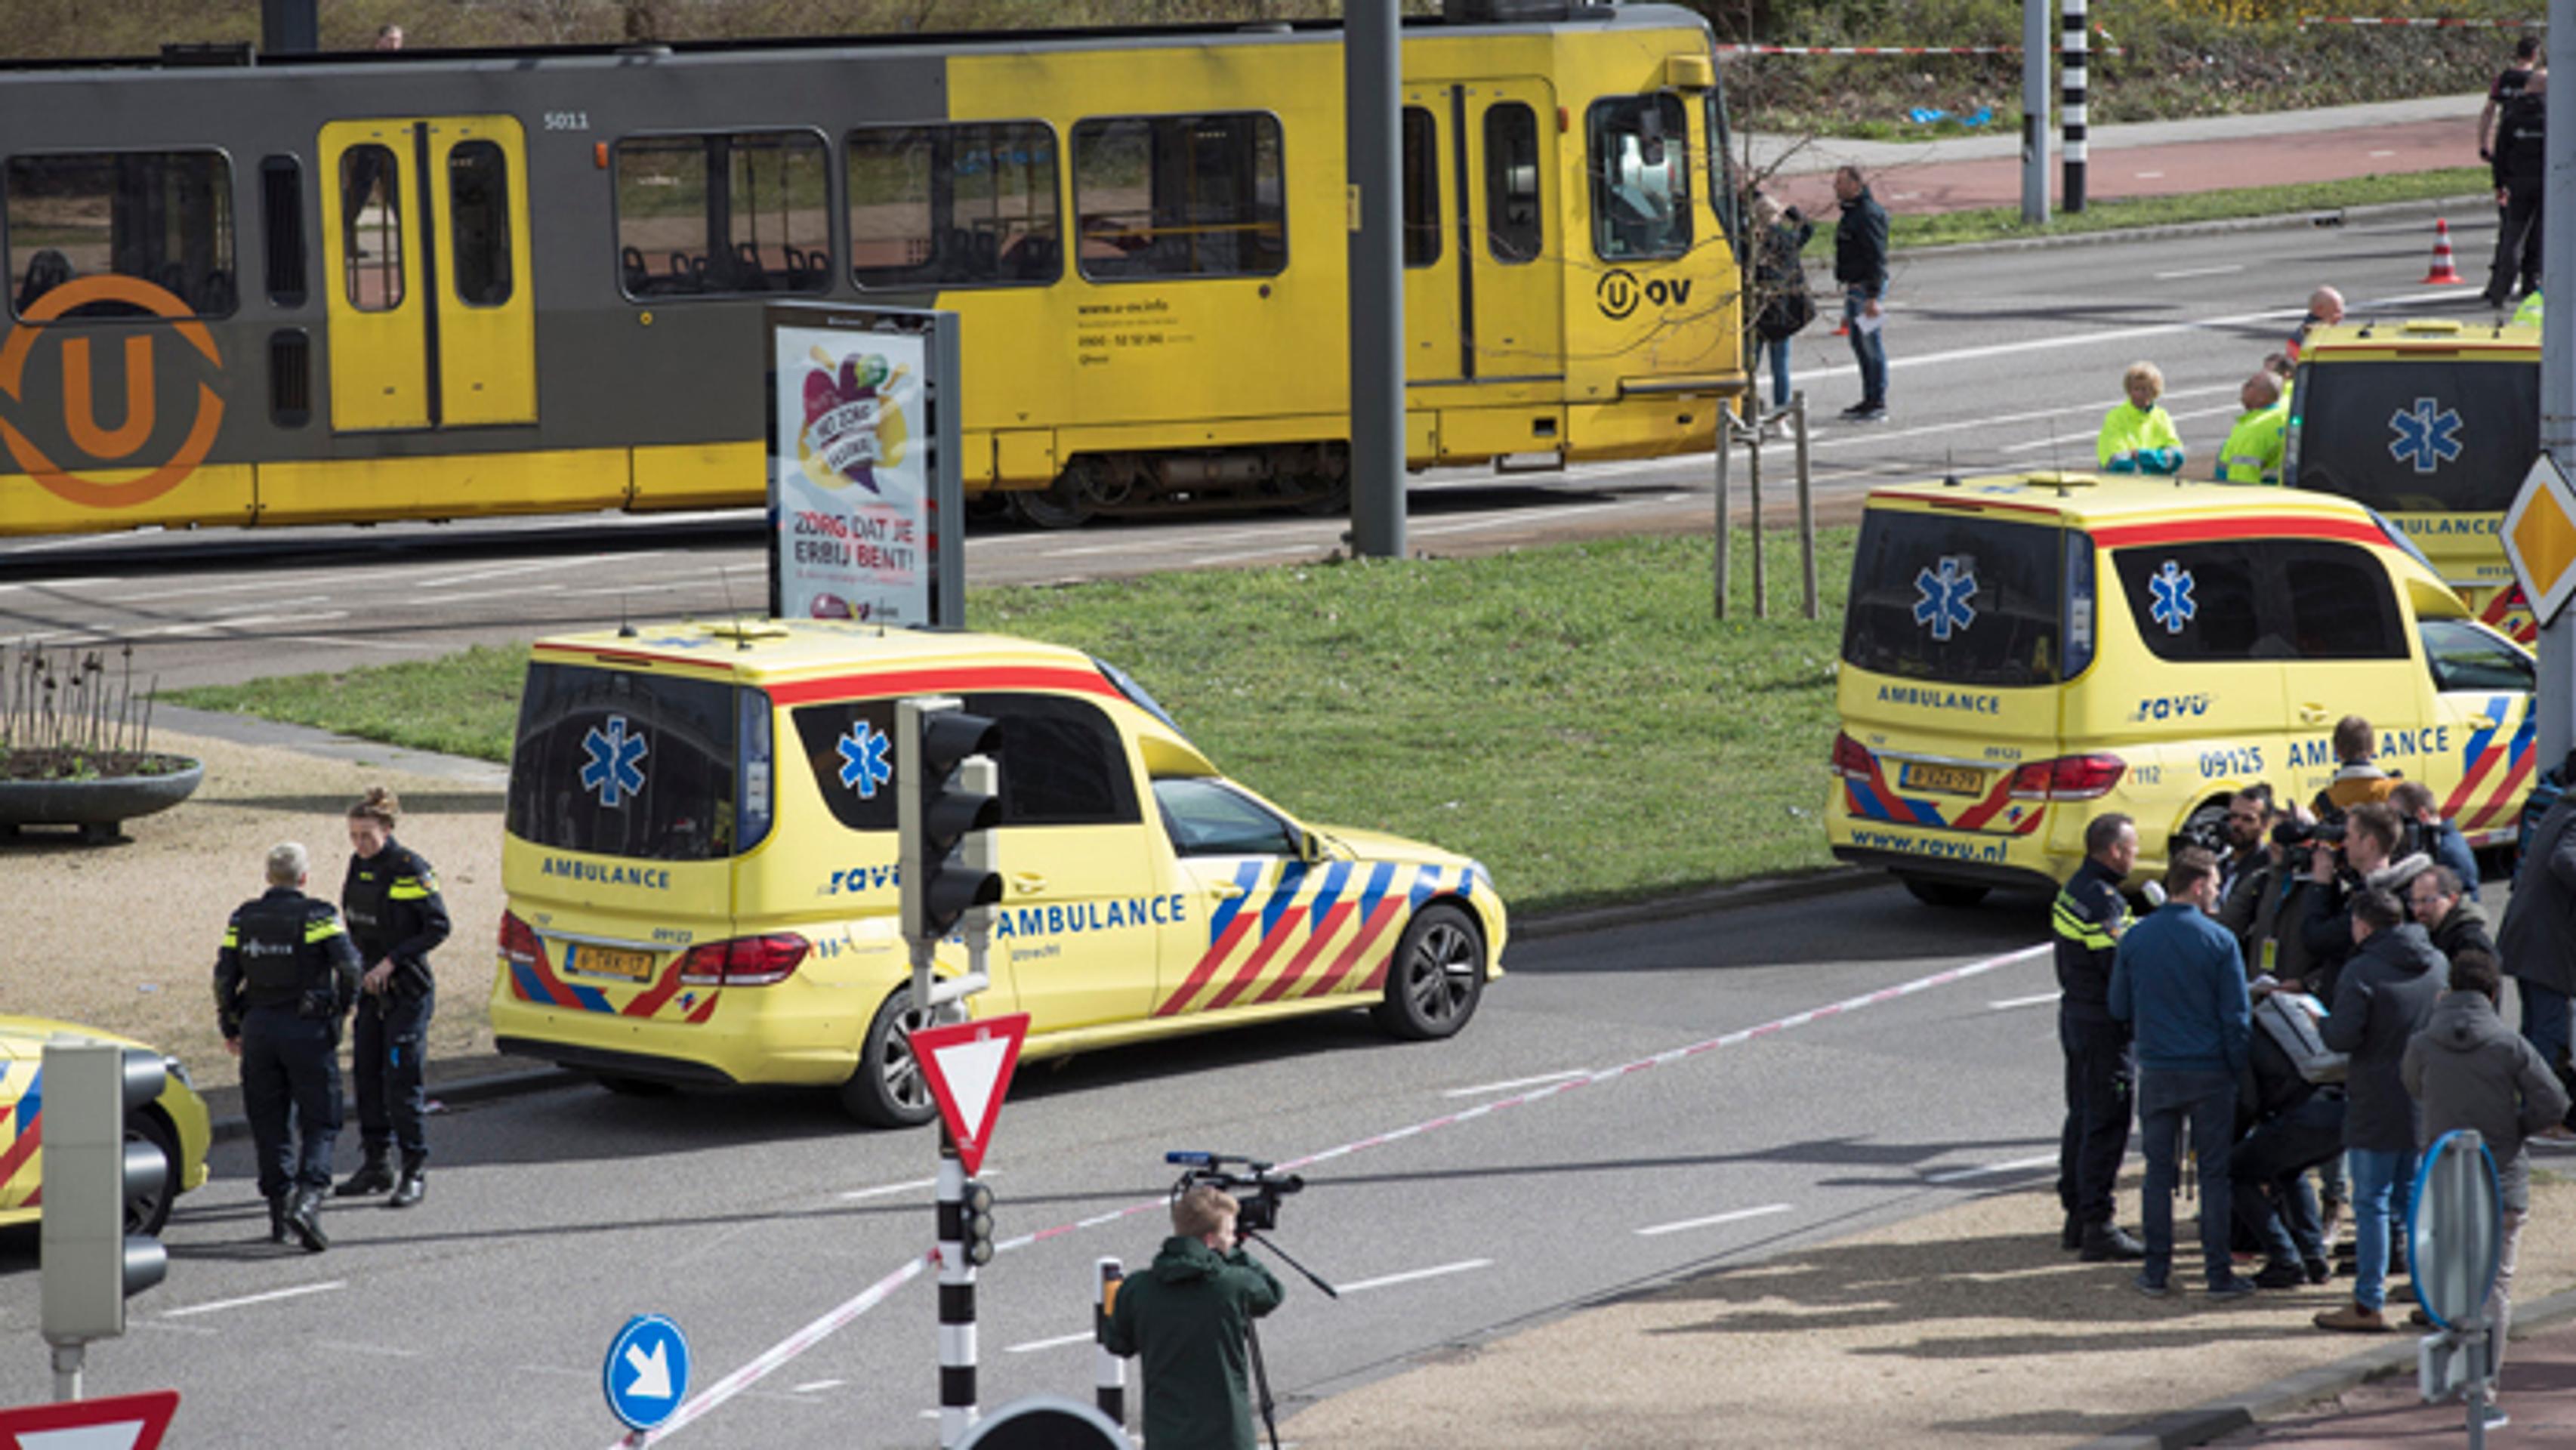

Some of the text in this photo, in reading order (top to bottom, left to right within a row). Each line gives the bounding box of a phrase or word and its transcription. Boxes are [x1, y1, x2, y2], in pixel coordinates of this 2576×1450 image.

[545, 113, 589, 130] 5011
[1645, 279, 1683, 306] OV
[62, 335, 156, 460] U
[853, 515, 887, 541] DAT
[893, 519, 914, 543] JE
[2392, 519, 2499, 535] BULANCE
[795, 541, 914, 572] ERBIJ BENT!
[1877, 685, 2000, 714] AMBULANCE
[2200, 746, 2264, 779] 09125
[2288, 726, 2449, 769] AMANCE
[1851, 829, 2007, 862] www.ravu.nl
[541, 857, 671, 890] AMBULANCE
[997, 893, 1186, 939] AMBULANCE
